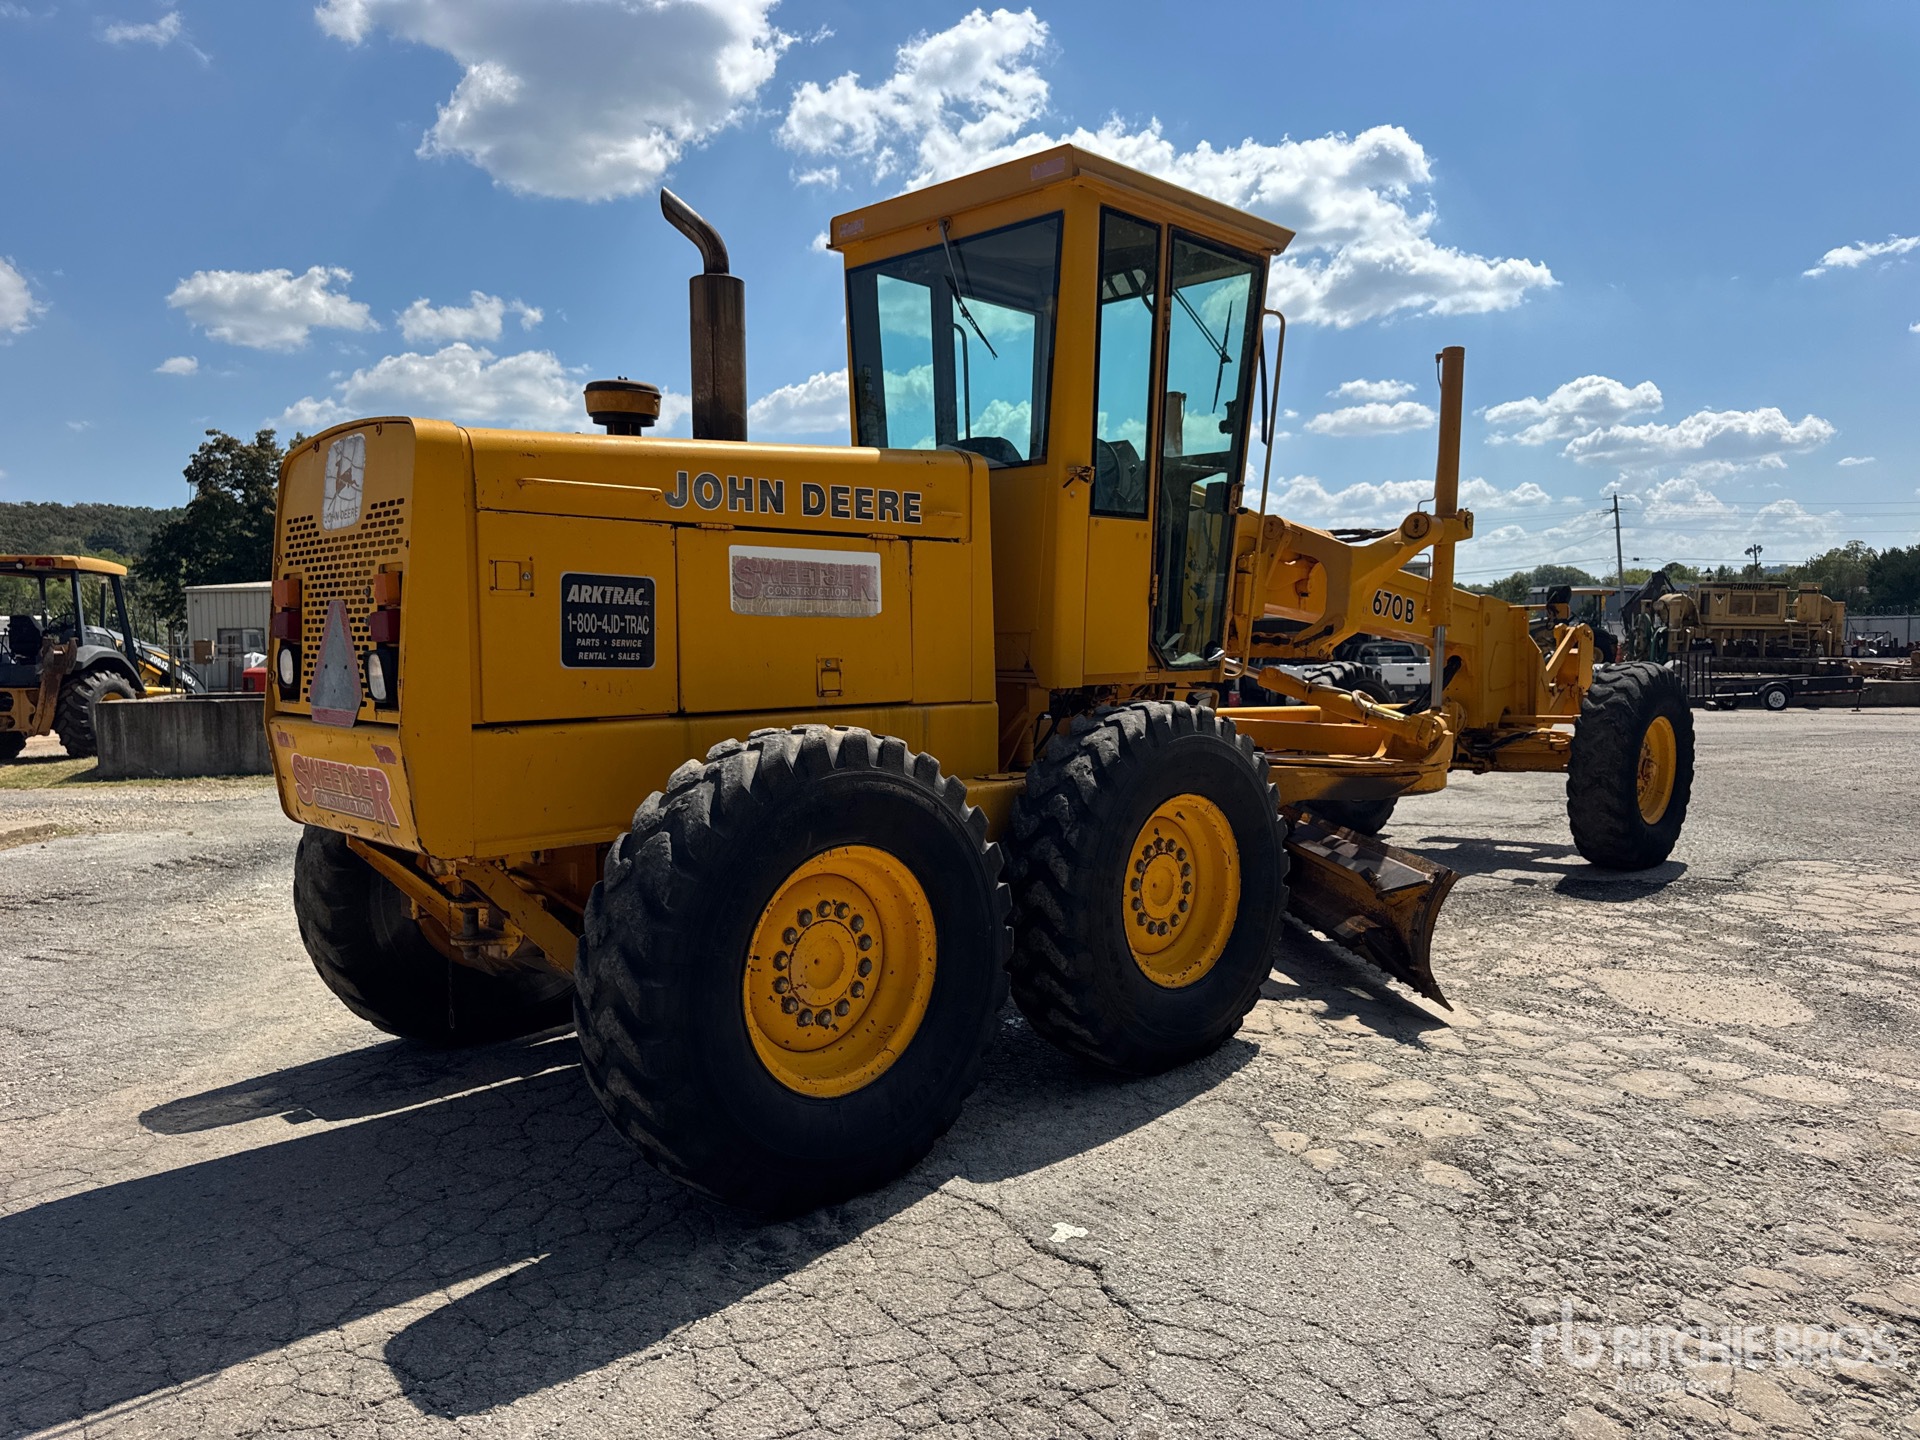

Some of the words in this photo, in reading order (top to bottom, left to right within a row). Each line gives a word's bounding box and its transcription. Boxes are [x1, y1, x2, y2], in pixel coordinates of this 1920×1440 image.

[664, 470, 785, 515] JOHN
[800, 482, 922, 525] DEERE
[733, 557, 878, 602] SWEETSER
[566, 584, 645, 606] ARKTRAC
[767, 585, 849, 598] CONSTRUCTION
[1372, 588, 1415, 624] 670B
[567, 612, 650, 634] 1-800-4JD-TRAC
[576, 638, 600, 647] PARTS
[611, 639, 643, 648] SERVICE
[578, 652, 607, 660] RENTAL
[617, 652, 641, 661] SALES
[291, 752, 400, 828] SWEETSER
[316, 791, 374, 816] CONSTRUCTION
